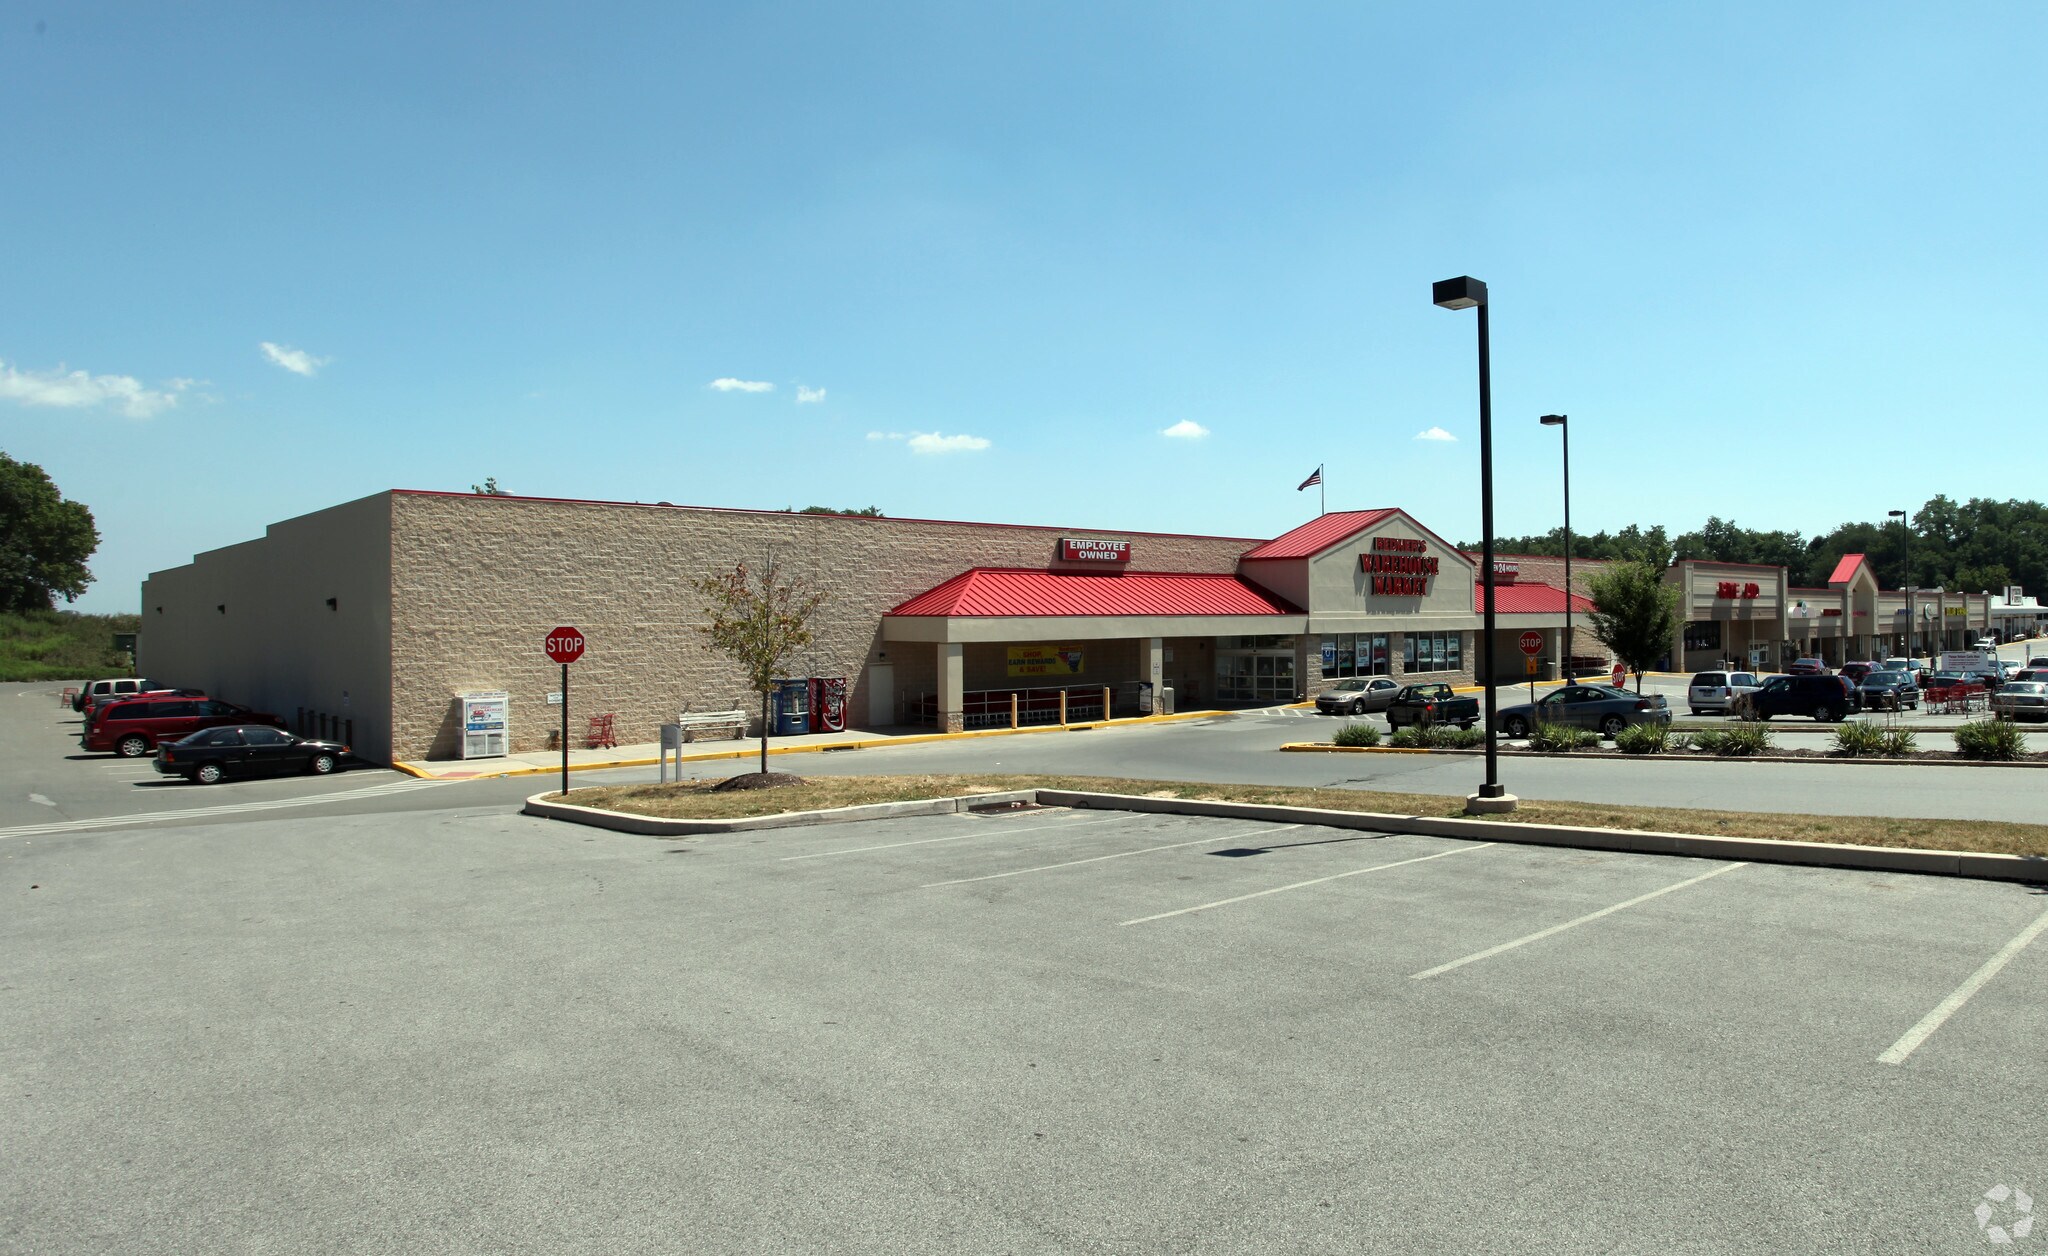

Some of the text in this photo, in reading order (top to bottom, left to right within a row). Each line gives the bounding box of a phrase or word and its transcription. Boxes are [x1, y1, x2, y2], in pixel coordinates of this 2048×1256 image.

[1069, 541, 1126, 551] EMPLOYEE
[1078, 550, 1118, 560] OWNED
[1359, 554, 1439, 575] WAREHOUSE
[1498, 563, 1506, 574] 24
[1506, 565, 1519, 573] HOURS
[1372, 576, 1427, 596] MARKET
[547, 637, 583, 653] STOP
[1520, 638, 1541, 648] STOP
[1612, 671, 1625, 684] STOP
